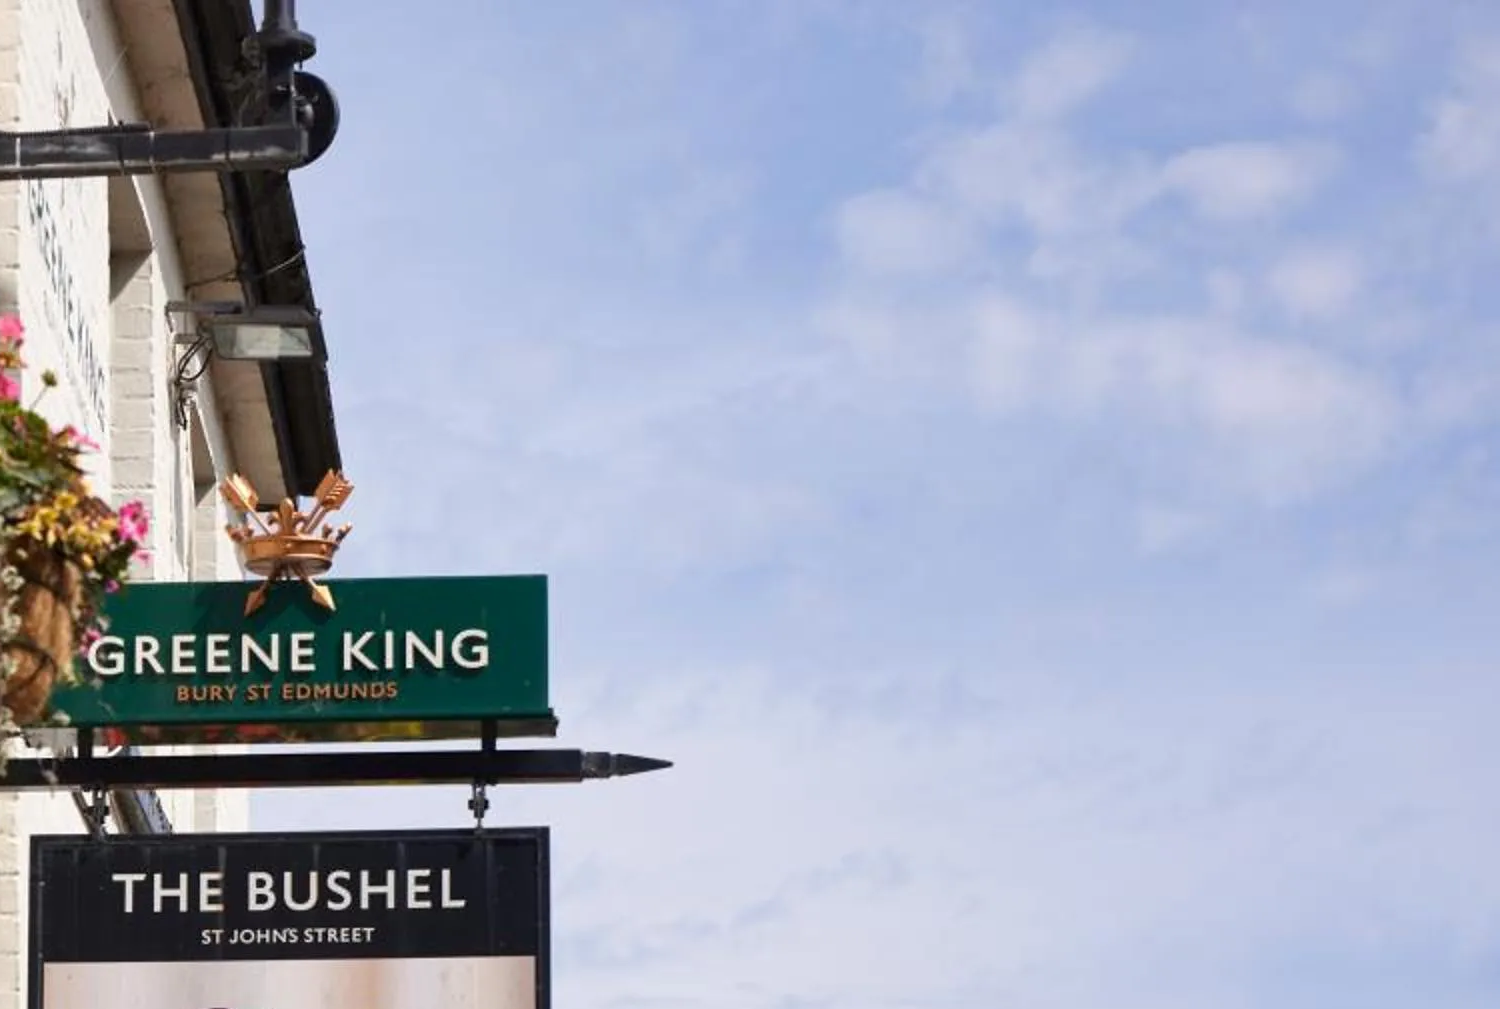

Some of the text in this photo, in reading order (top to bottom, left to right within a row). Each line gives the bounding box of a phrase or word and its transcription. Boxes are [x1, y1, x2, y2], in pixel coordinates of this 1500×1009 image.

[87, 628, 490, 676] GREENE KING
[176, 681, 398, 701] BURY ST EDMUNDS
[112, 868, 467, 913] THE BUSHEL
[201, 929, 224, 945] ST
[303, 927, 375, 943] STREET
